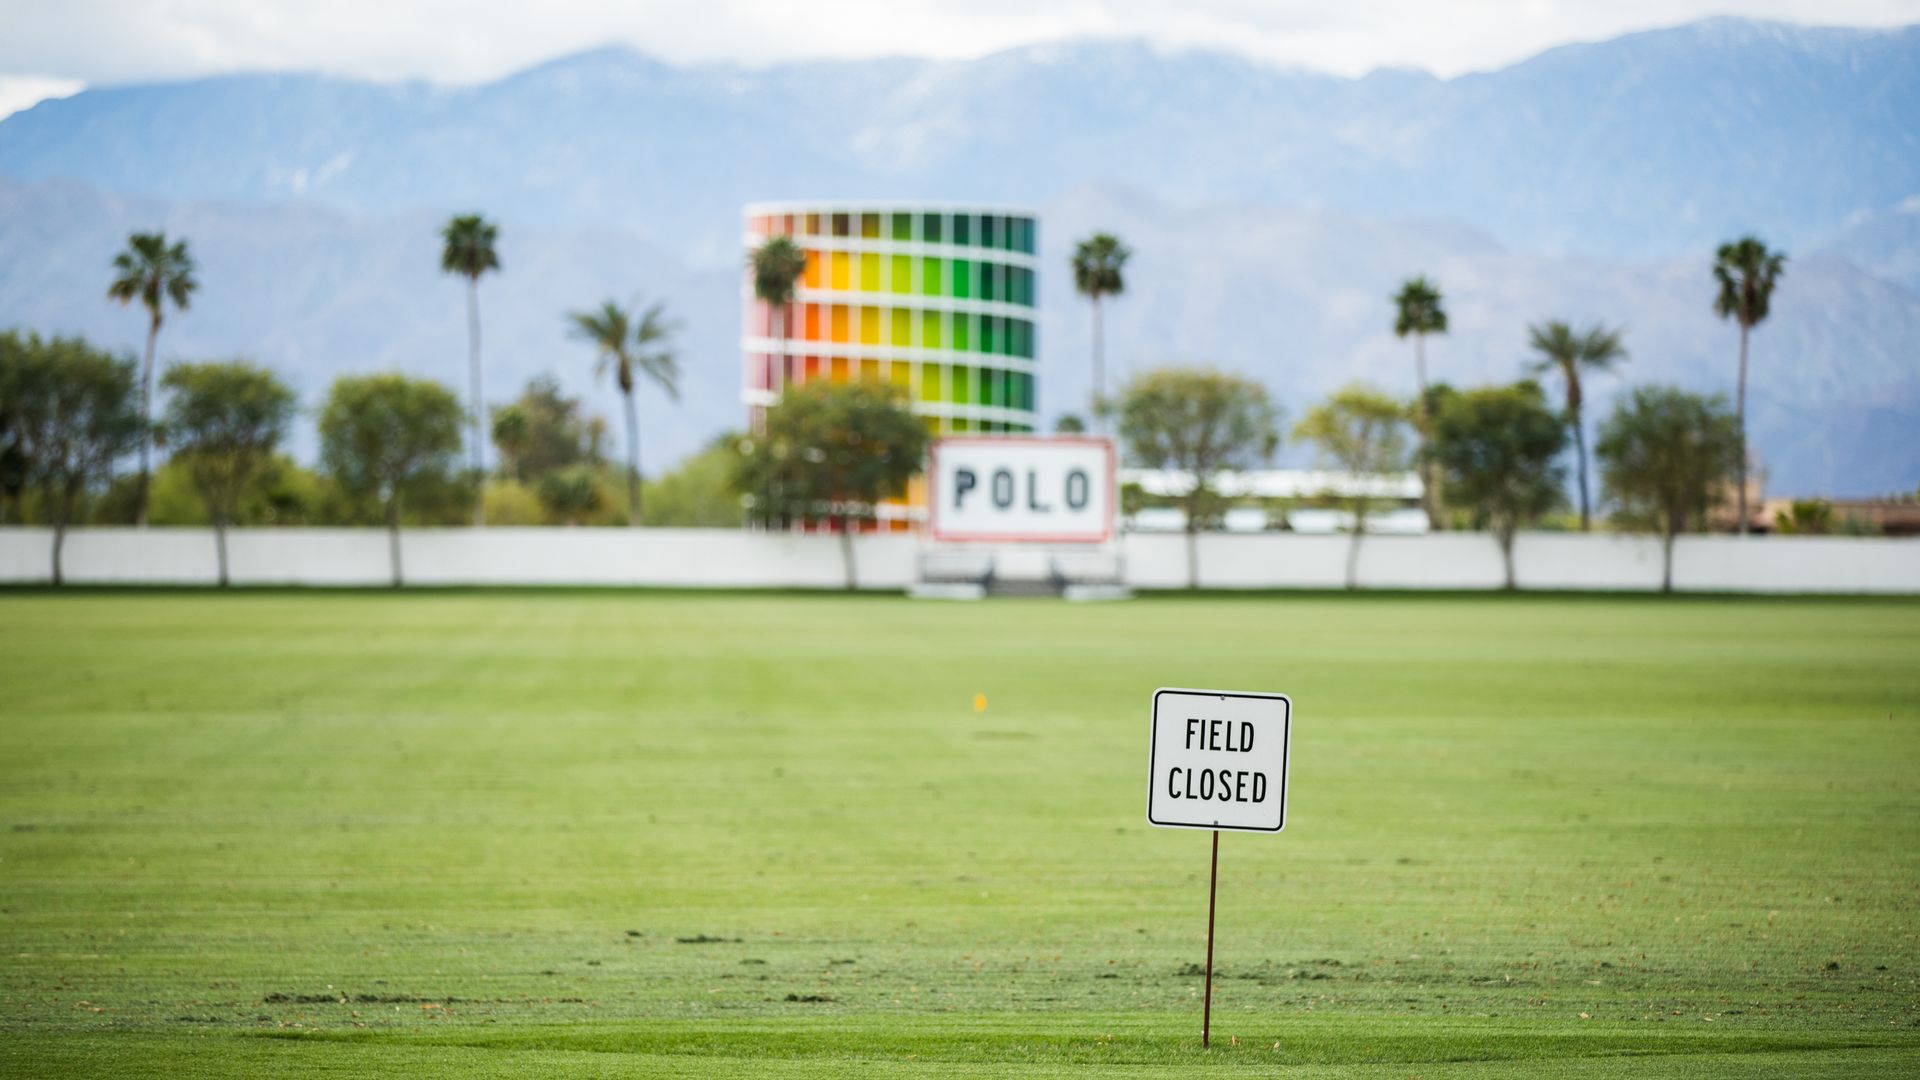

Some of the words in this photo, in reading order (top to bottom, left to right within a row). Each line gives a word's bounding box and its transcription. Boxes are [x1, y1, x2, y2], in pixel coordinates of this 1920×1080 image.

[954, 467, 1090, 512] POLO
[1185, 718, 1255, 753] FIELD
[1168, 766, 1267, 803] CLOSED
